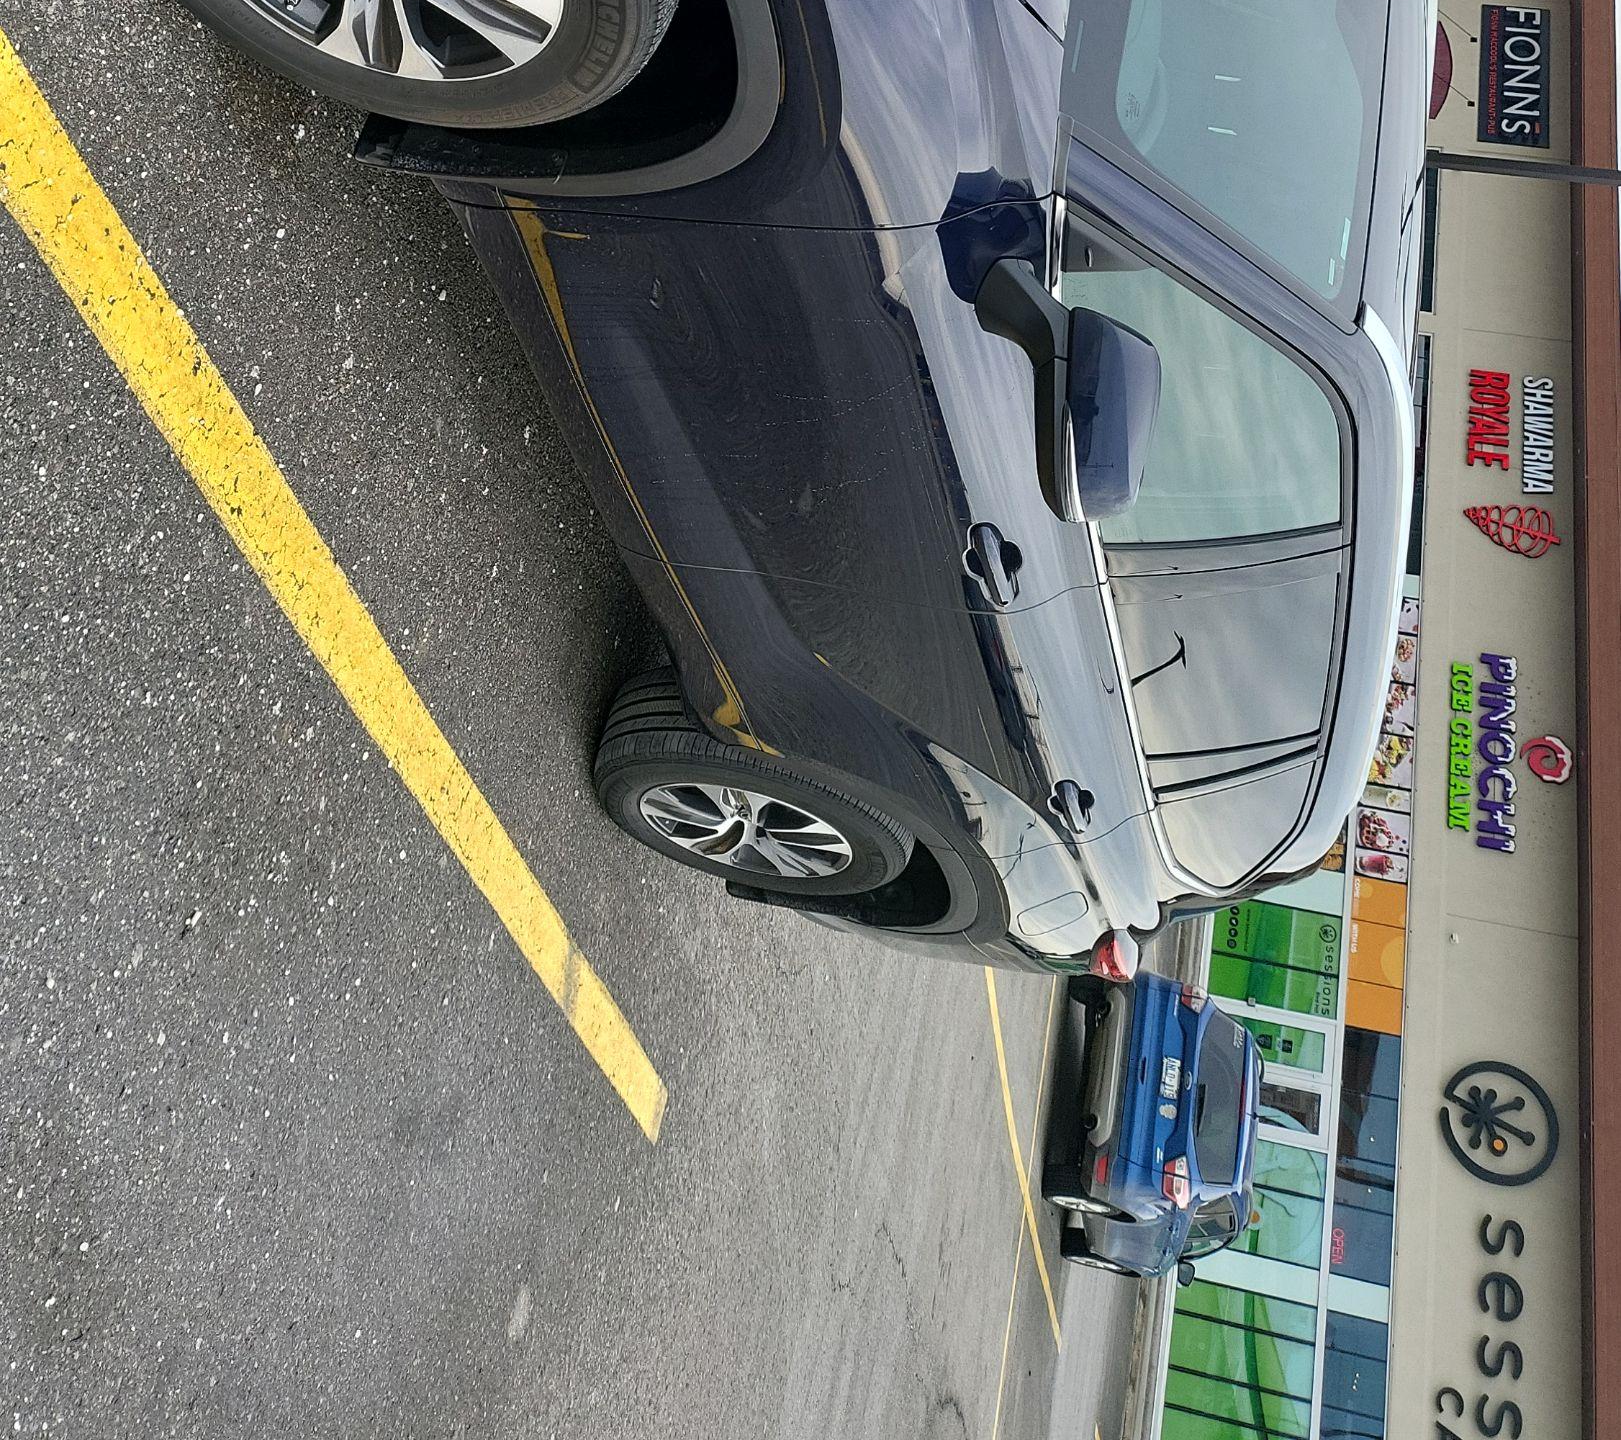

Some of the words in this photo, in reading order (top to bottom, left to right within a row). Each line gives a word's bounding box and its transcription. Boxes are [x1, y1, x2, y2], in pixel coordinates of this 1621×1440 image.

[1466, 369, 1511, 471] ROYALE
[1522, 376, 1555, 494] SHAWARMA
[1450, 662, 1473, 711] ICE
[1447, 717, 1472, 832] CREAM
[1476, 653, 1518, 854] PINOCHI
[1331, 1228, 1345, 1264] OPEN
